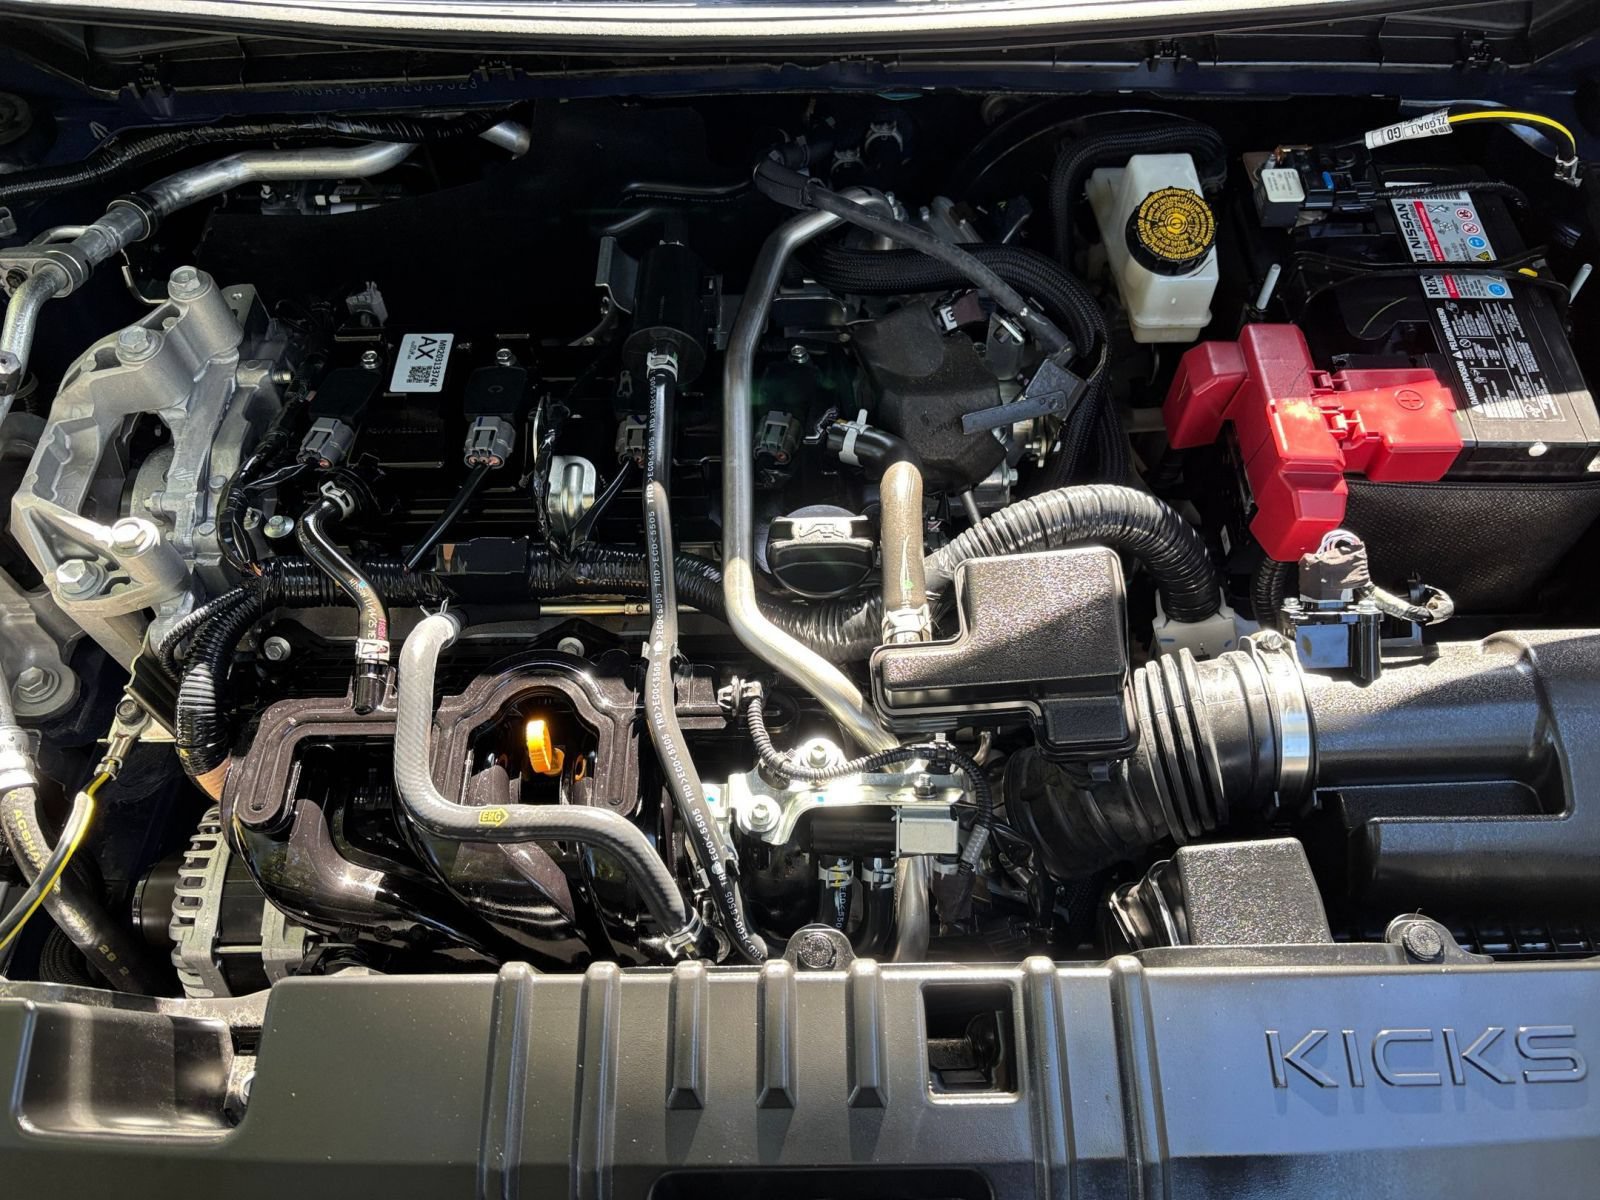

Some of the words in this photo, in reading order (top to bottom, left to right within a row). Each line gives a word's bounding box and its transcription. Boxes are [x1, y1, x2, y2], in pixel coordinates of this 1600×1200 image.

[1395, 203, 1421, 249] NISSAN
[415, 336, 438, 360] AX
[1264, 1025, 1588, 1089] KICKS
